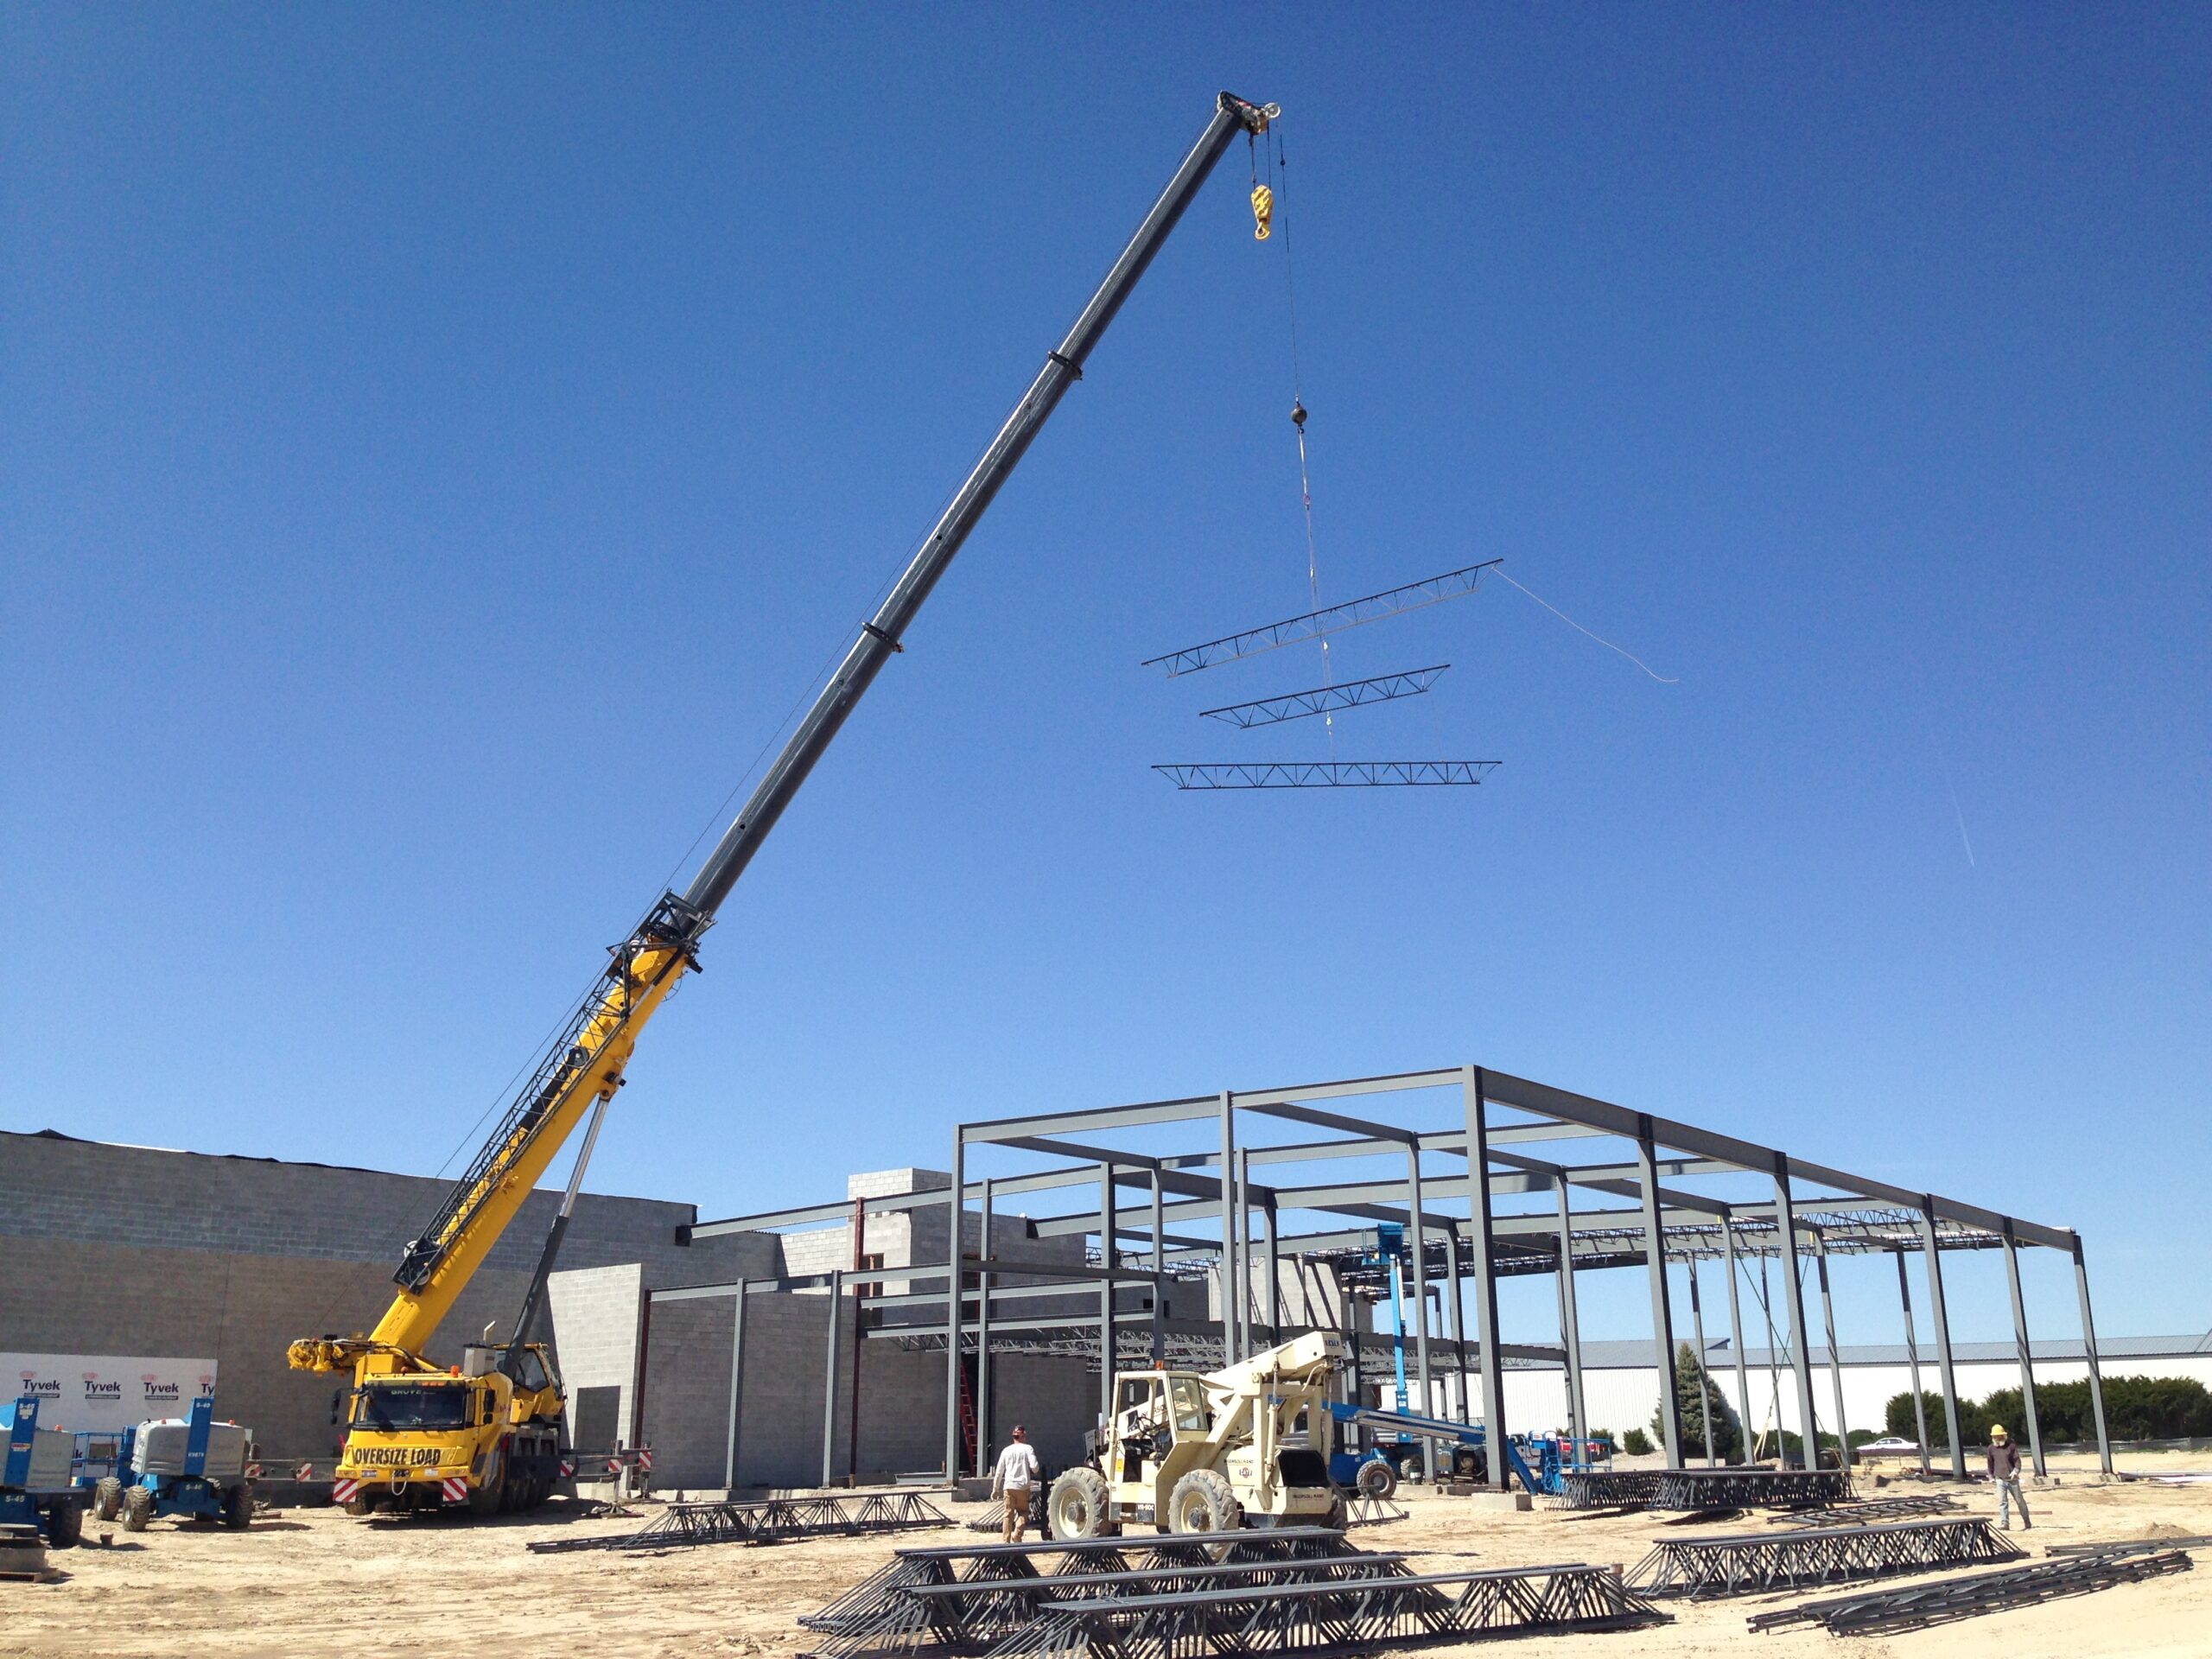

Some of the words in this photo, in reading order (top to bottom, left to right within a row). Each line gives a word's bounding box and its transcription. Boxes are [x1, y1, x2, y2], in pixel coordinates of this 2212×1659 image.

[22, 1379, 60, 1392] Tyvek
[85, 1381, 121, 1393] Tyvek
[143, 1382, 179, 1395] Tyvek
[355, 1448, 408, 1465] OVERSIZE
[410, 1448, 442, 1465] LOAD
